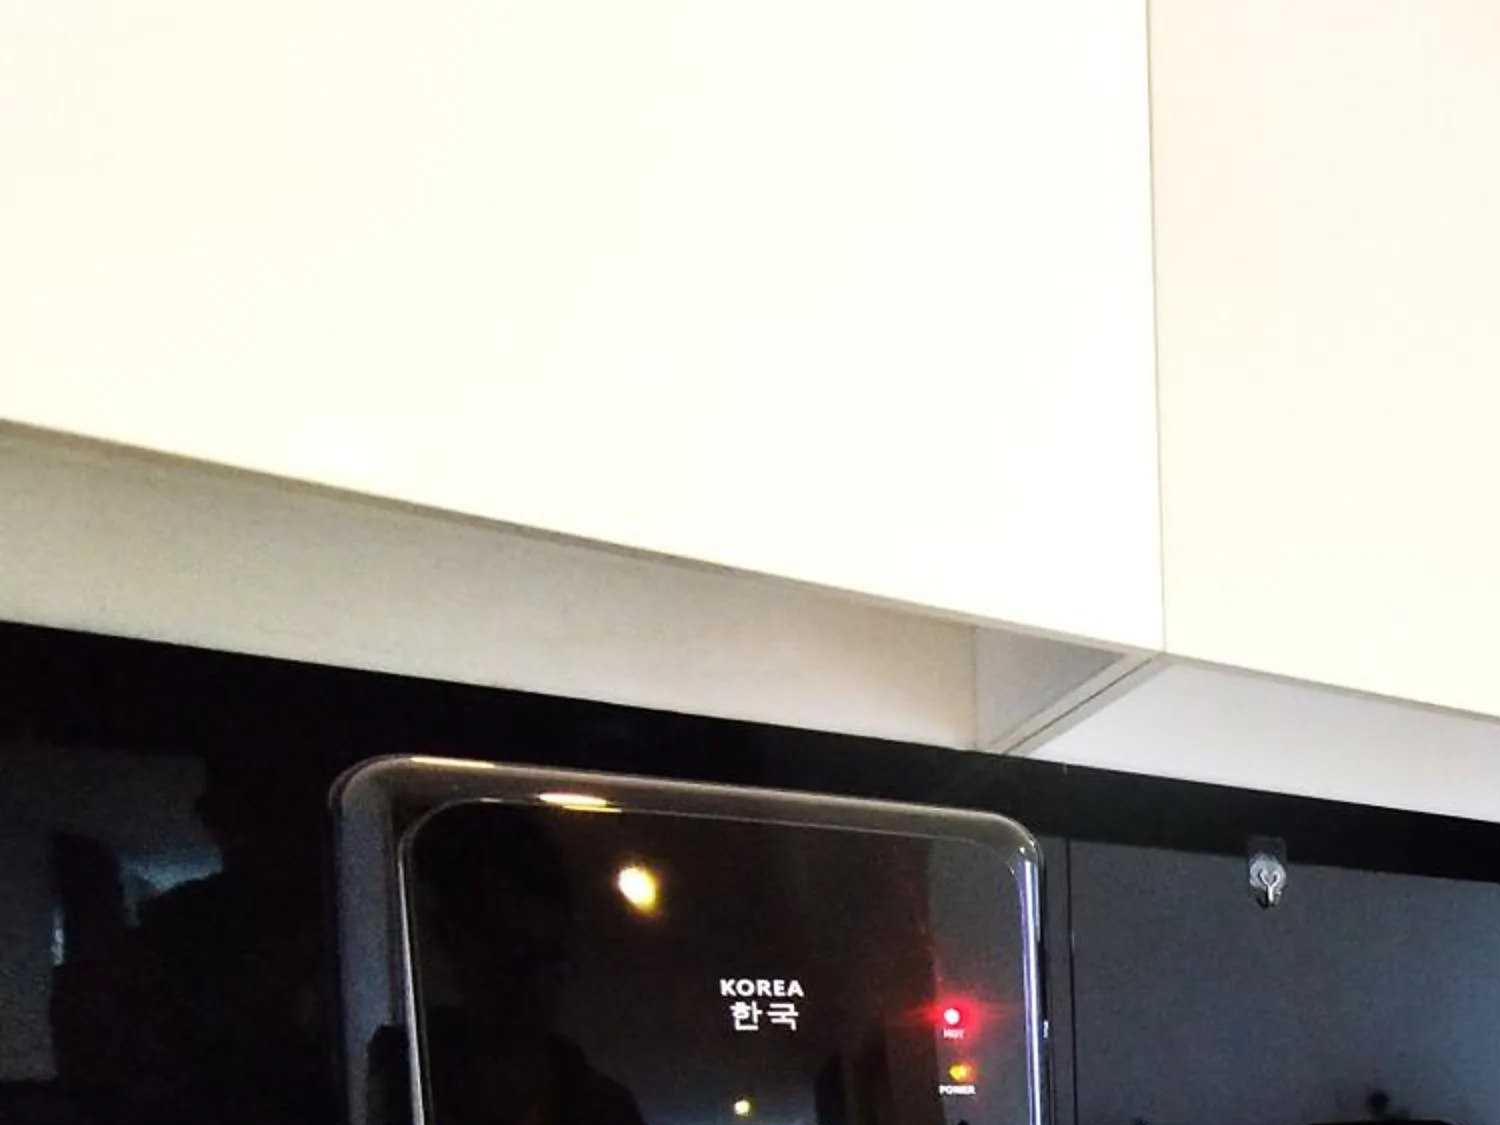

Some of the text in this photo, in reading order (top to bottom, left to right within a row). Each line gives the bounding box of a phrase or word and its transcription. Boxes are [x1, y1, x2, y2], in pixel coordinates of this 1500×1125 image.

[720, 979, 804, 997] KOREA
[730, 1001, 799, 1031] 한국
[939, 1085, 976, 1096] POWER
